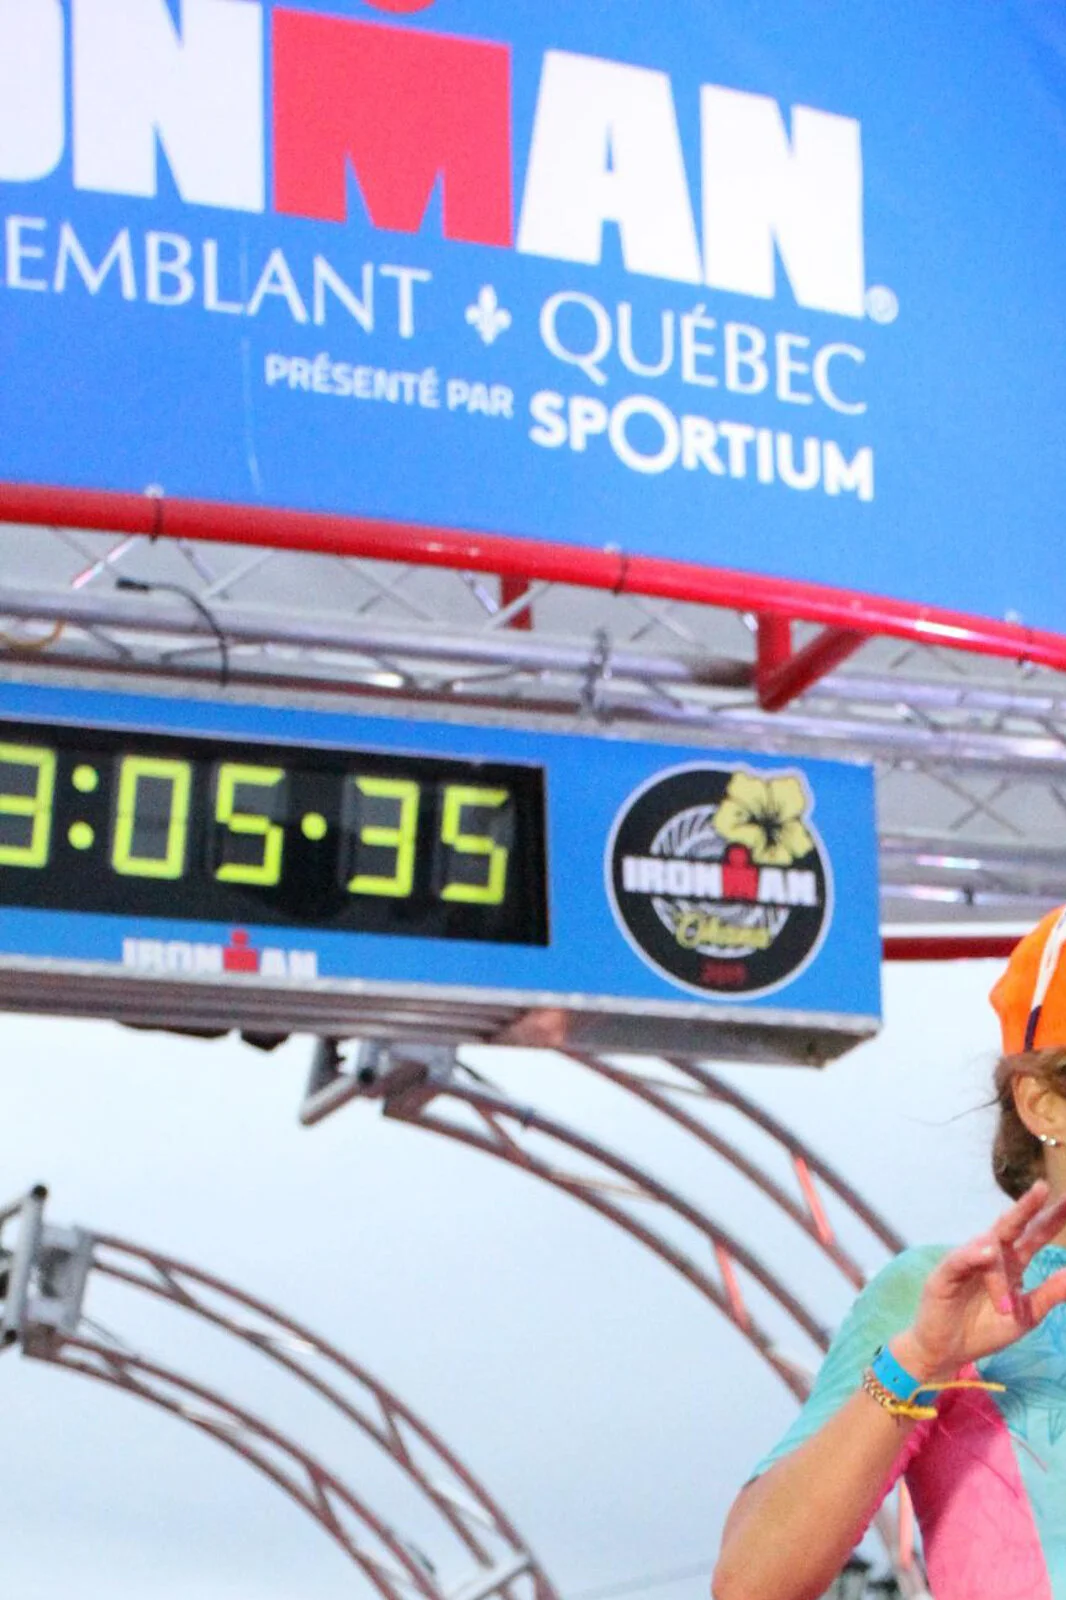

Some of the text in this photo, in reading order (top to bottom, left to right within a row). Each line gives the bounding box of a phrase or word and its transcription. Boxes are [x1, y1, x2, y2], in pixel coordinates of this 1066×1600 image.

[5, 214, 868, 415] EMBLANT QUÉBEC
[264, 351, 875, 502] PRÉSENTÉ PAR SPORTIUM
[622, 846, 817, 907] IRONMAN
[122, 930, 318, 981] IRONMAN
